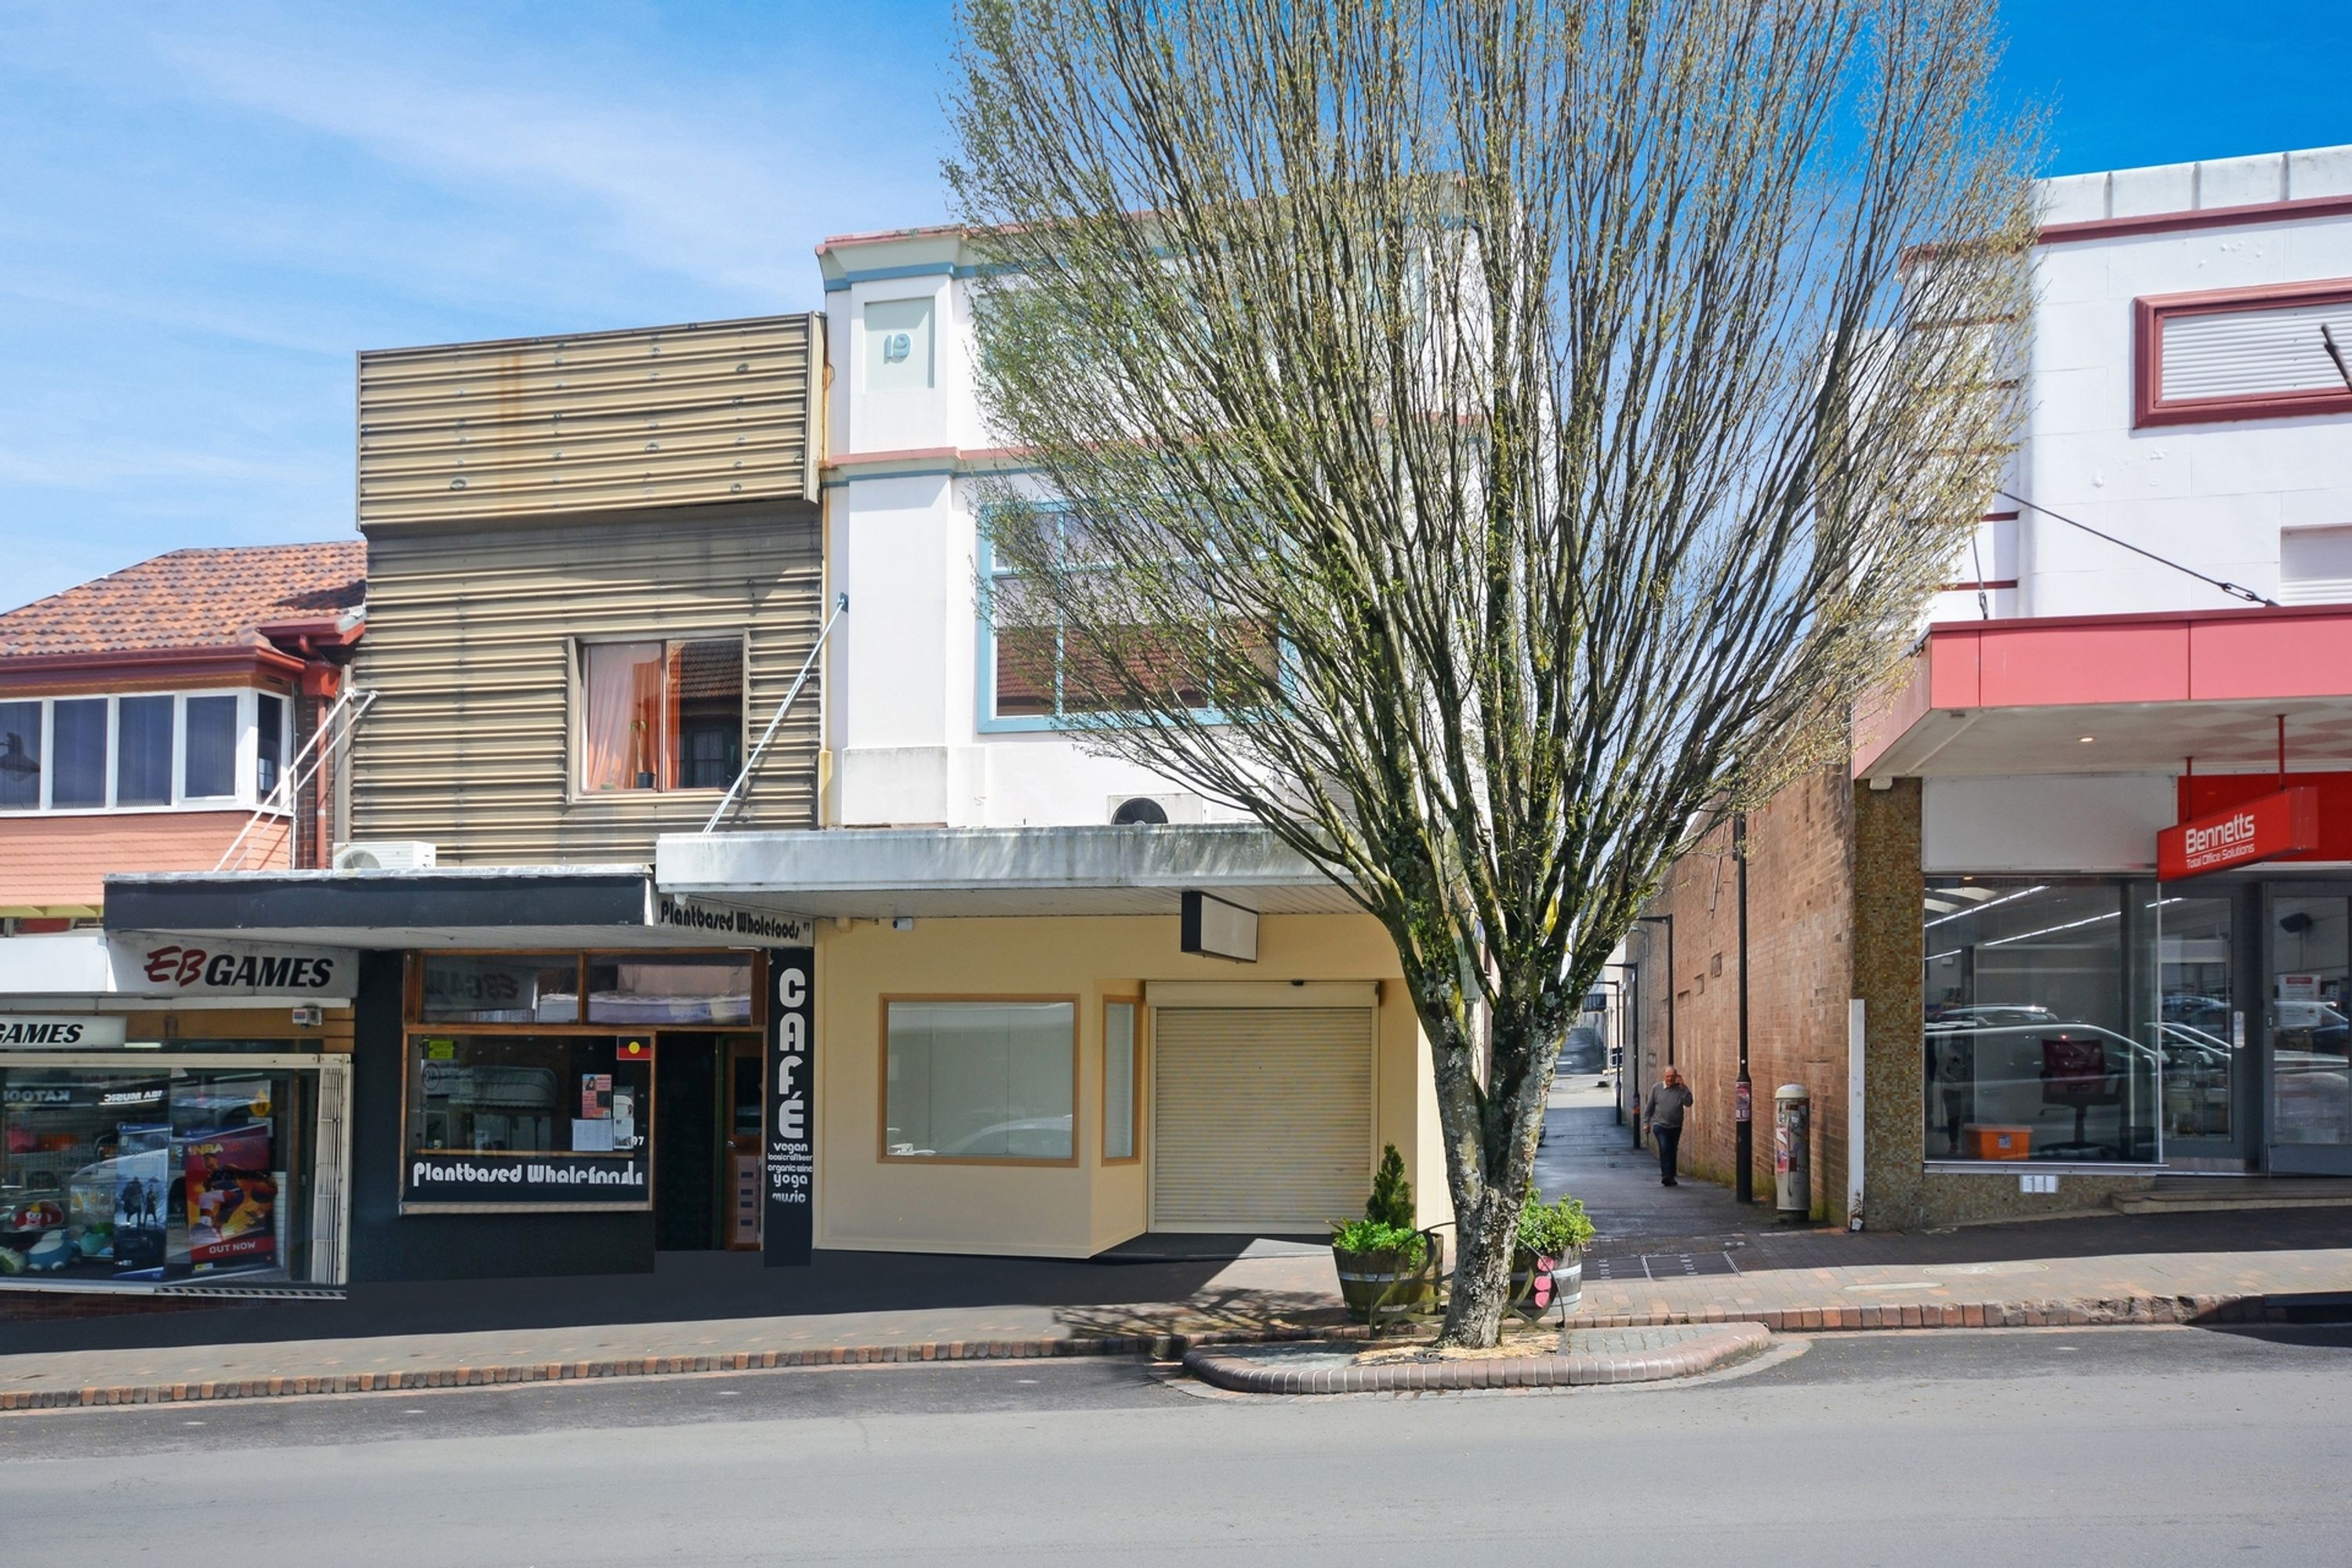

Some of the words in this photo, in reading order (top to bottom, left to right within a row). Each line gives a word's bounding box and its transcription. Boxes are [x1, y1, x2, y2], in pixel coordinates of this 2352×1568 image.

[884, 333, 911, 364] 19
[2186, 813, 2255, 854] Bennetts
[2186, 856, 2201, 869] Total
[2222, 844, 2255, 860] Solutions
[661, 901, 734, 931] Plantbased
[736, 911, 800, 940] Wholefoods
[143, 946, 207, 987] EB
[205, 954, 334, 988] GAMES
[779, 967, 806, 1139] CAFÉ
[192, 1143, 224, 1155] NBA
[773, 1142, 808, 1154] vegan
[413, 1162, 522, 1187] Plantbased
[768, 1163, 796, 1174] organic
[773, 1174, 808, 1188] yoga
[771, 1189, 806, 1203] music
[209, 1244, 230, 1254] OUT
[233, 1241, 256, 1250] NOW
